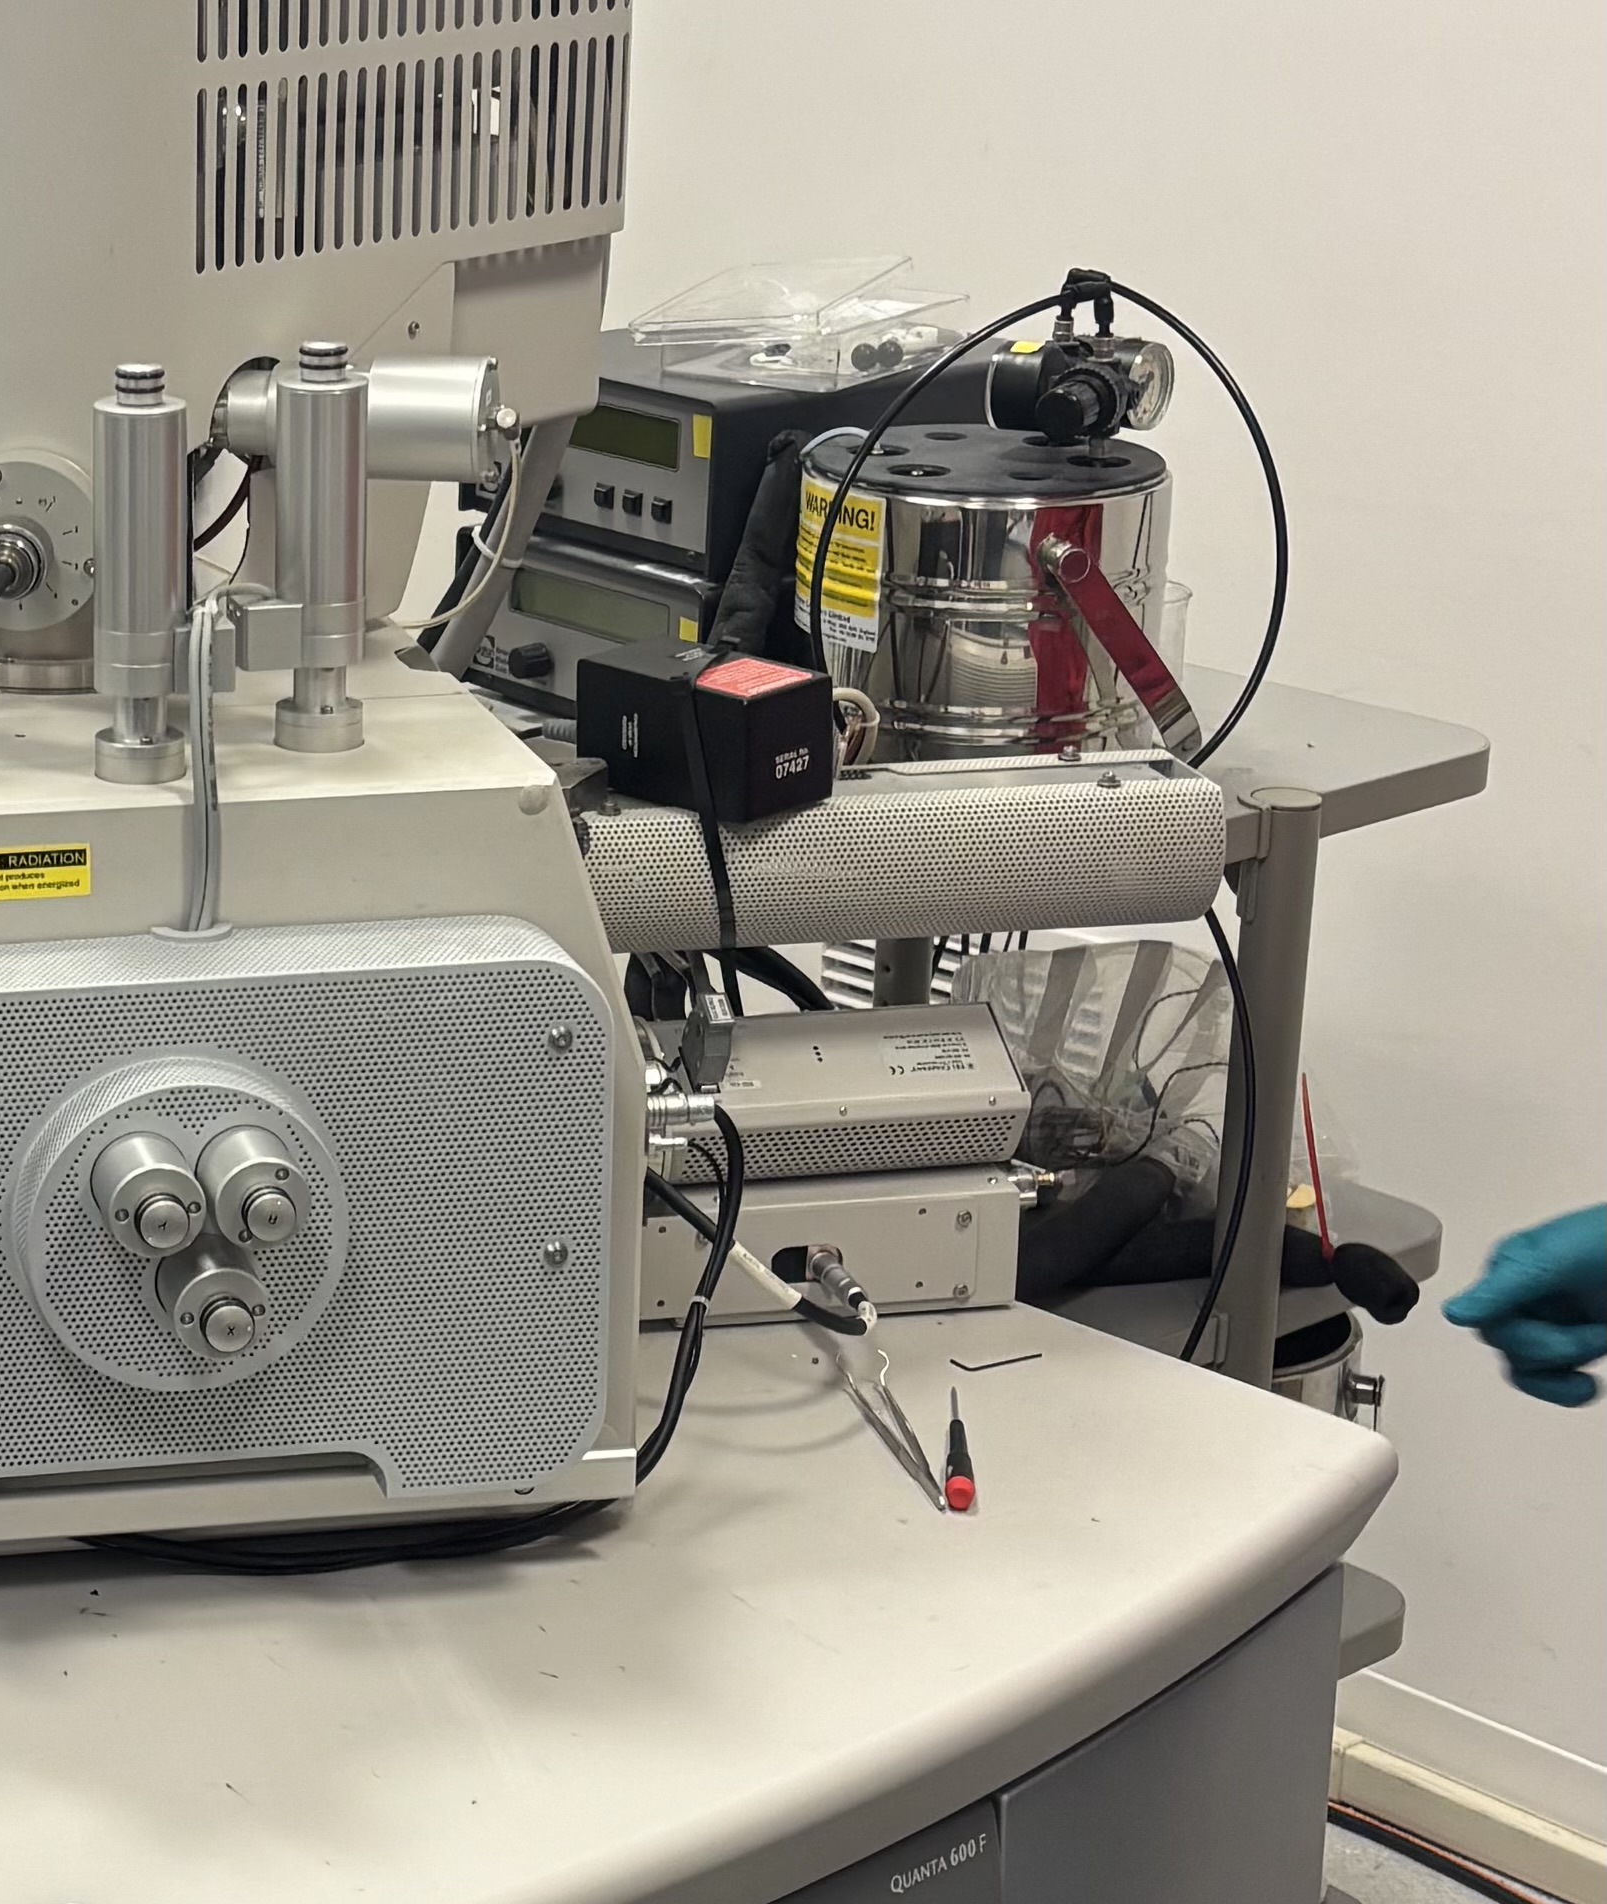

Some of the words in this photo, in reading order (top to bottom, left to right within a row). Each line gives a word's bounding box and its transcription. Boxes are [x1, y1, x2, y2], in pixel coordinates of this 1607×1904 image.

[805, 490, 876, 532] WARING!
[8, 852, 85, 868] RADIATION
[5, 871, 45, 883] produces
[11, 881, 35, 891] when
[36, 879, 80, 891] energized
[890, 1855, 948, 1894] QUANTA
[949, 1838, 977, 1867] 600
[978, 1833, 987, 1853] F
